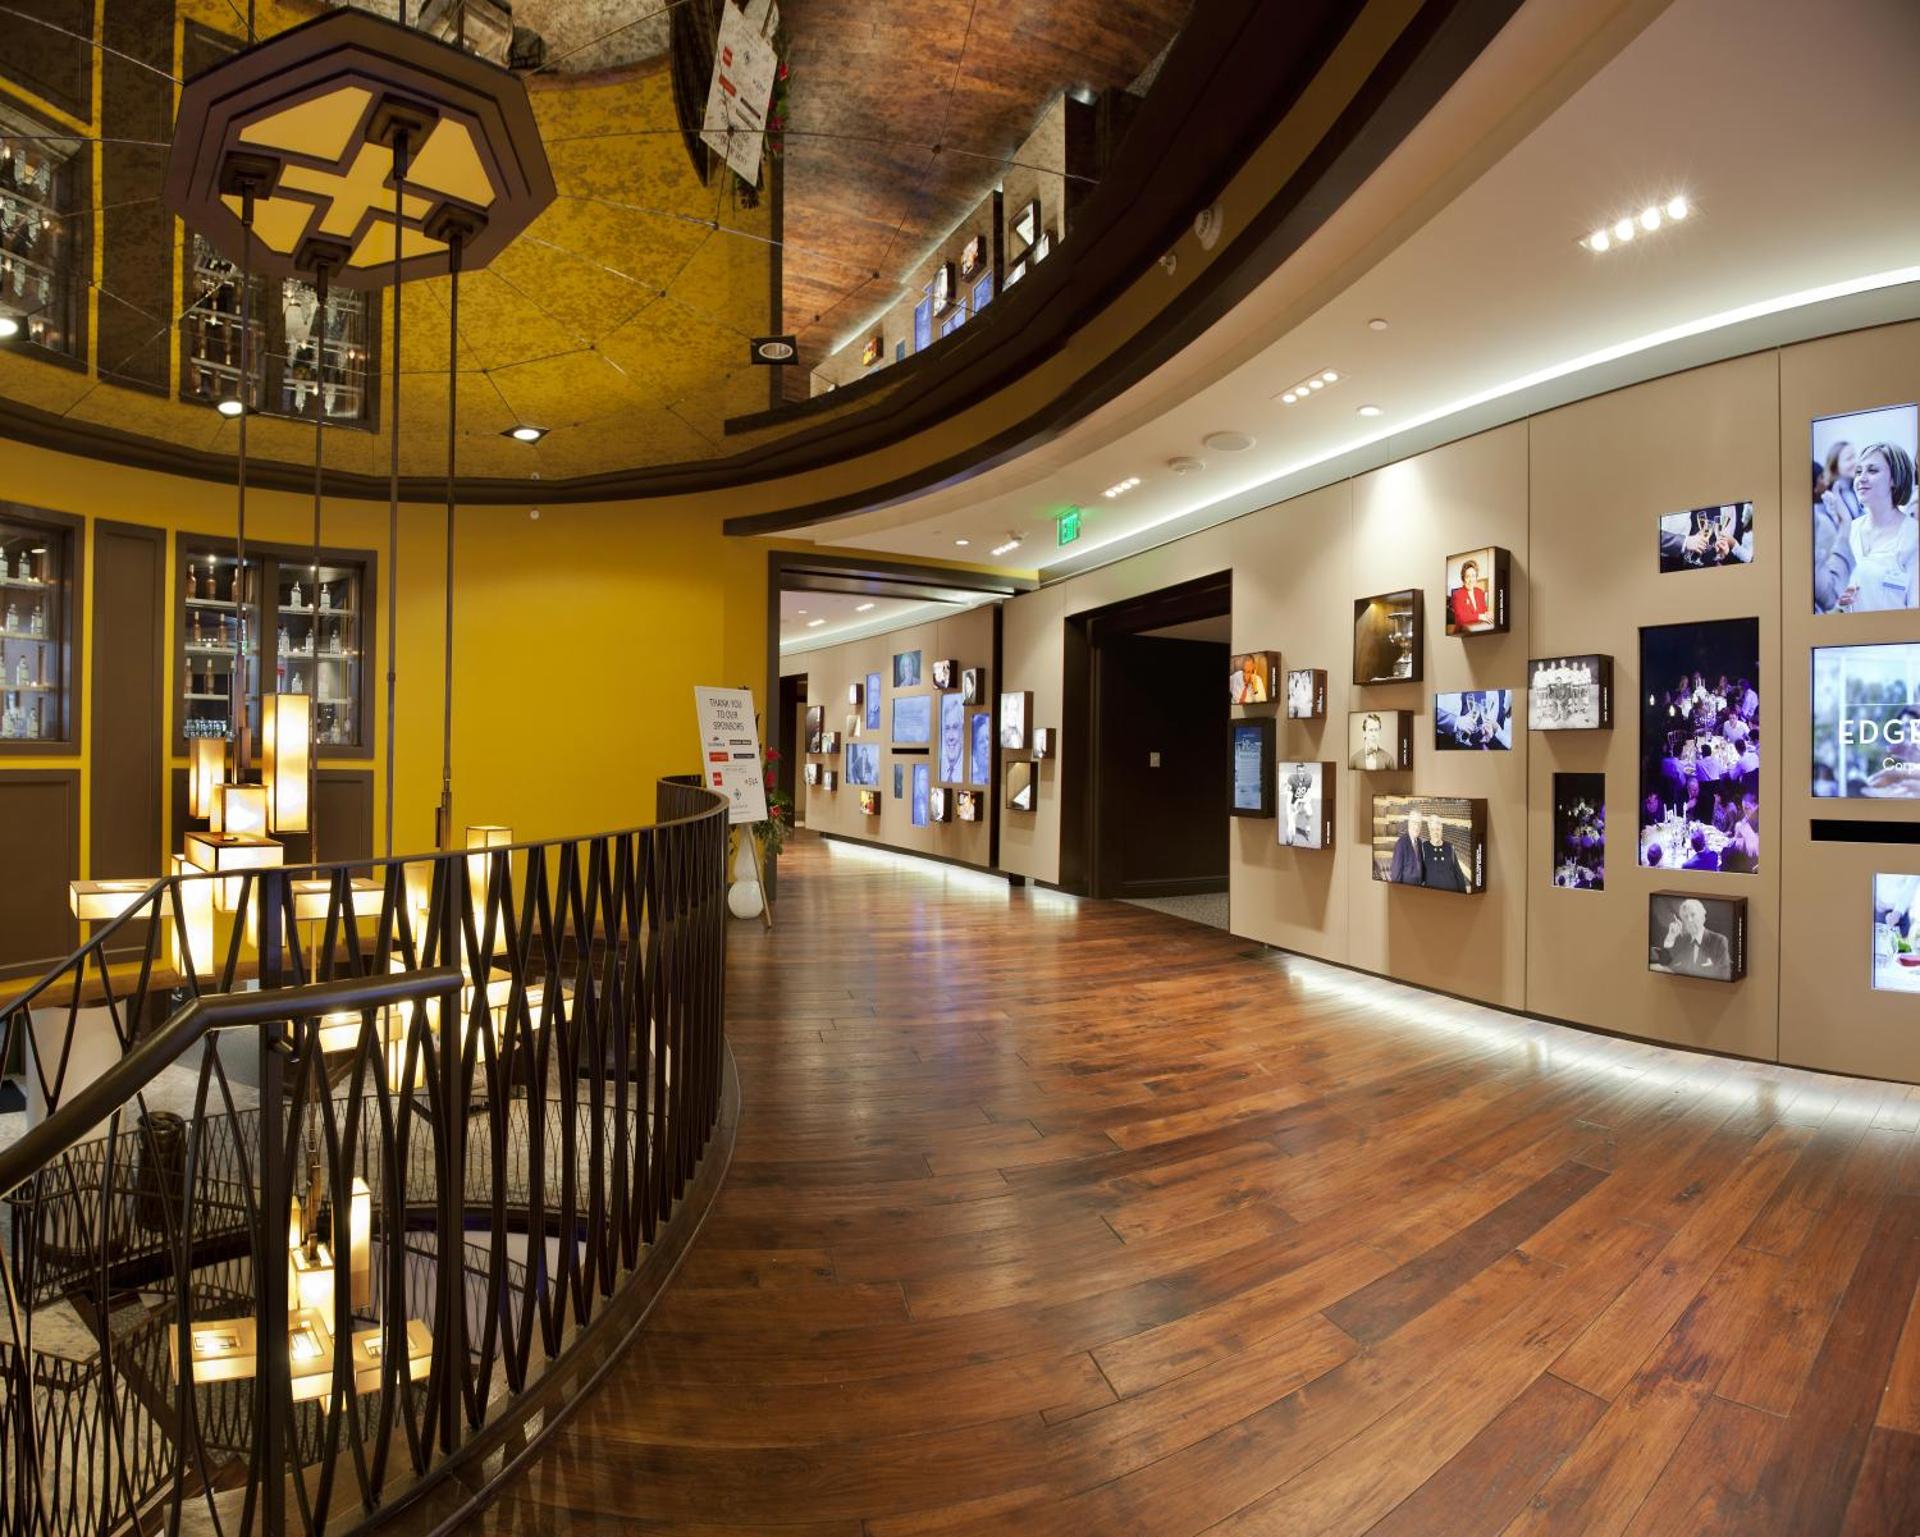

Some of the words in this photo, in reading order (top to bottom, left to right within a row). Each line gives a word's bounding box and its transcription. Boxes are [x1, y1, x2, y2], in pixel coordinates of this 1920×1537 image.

[709, 698, 729, 709] THANK
[731, 699, 743, 709] YOU
[716, 709, 725, 719] TO
[726, 710, 738, 720] OUR
[712, 721, 744, 732] SPONSORS
